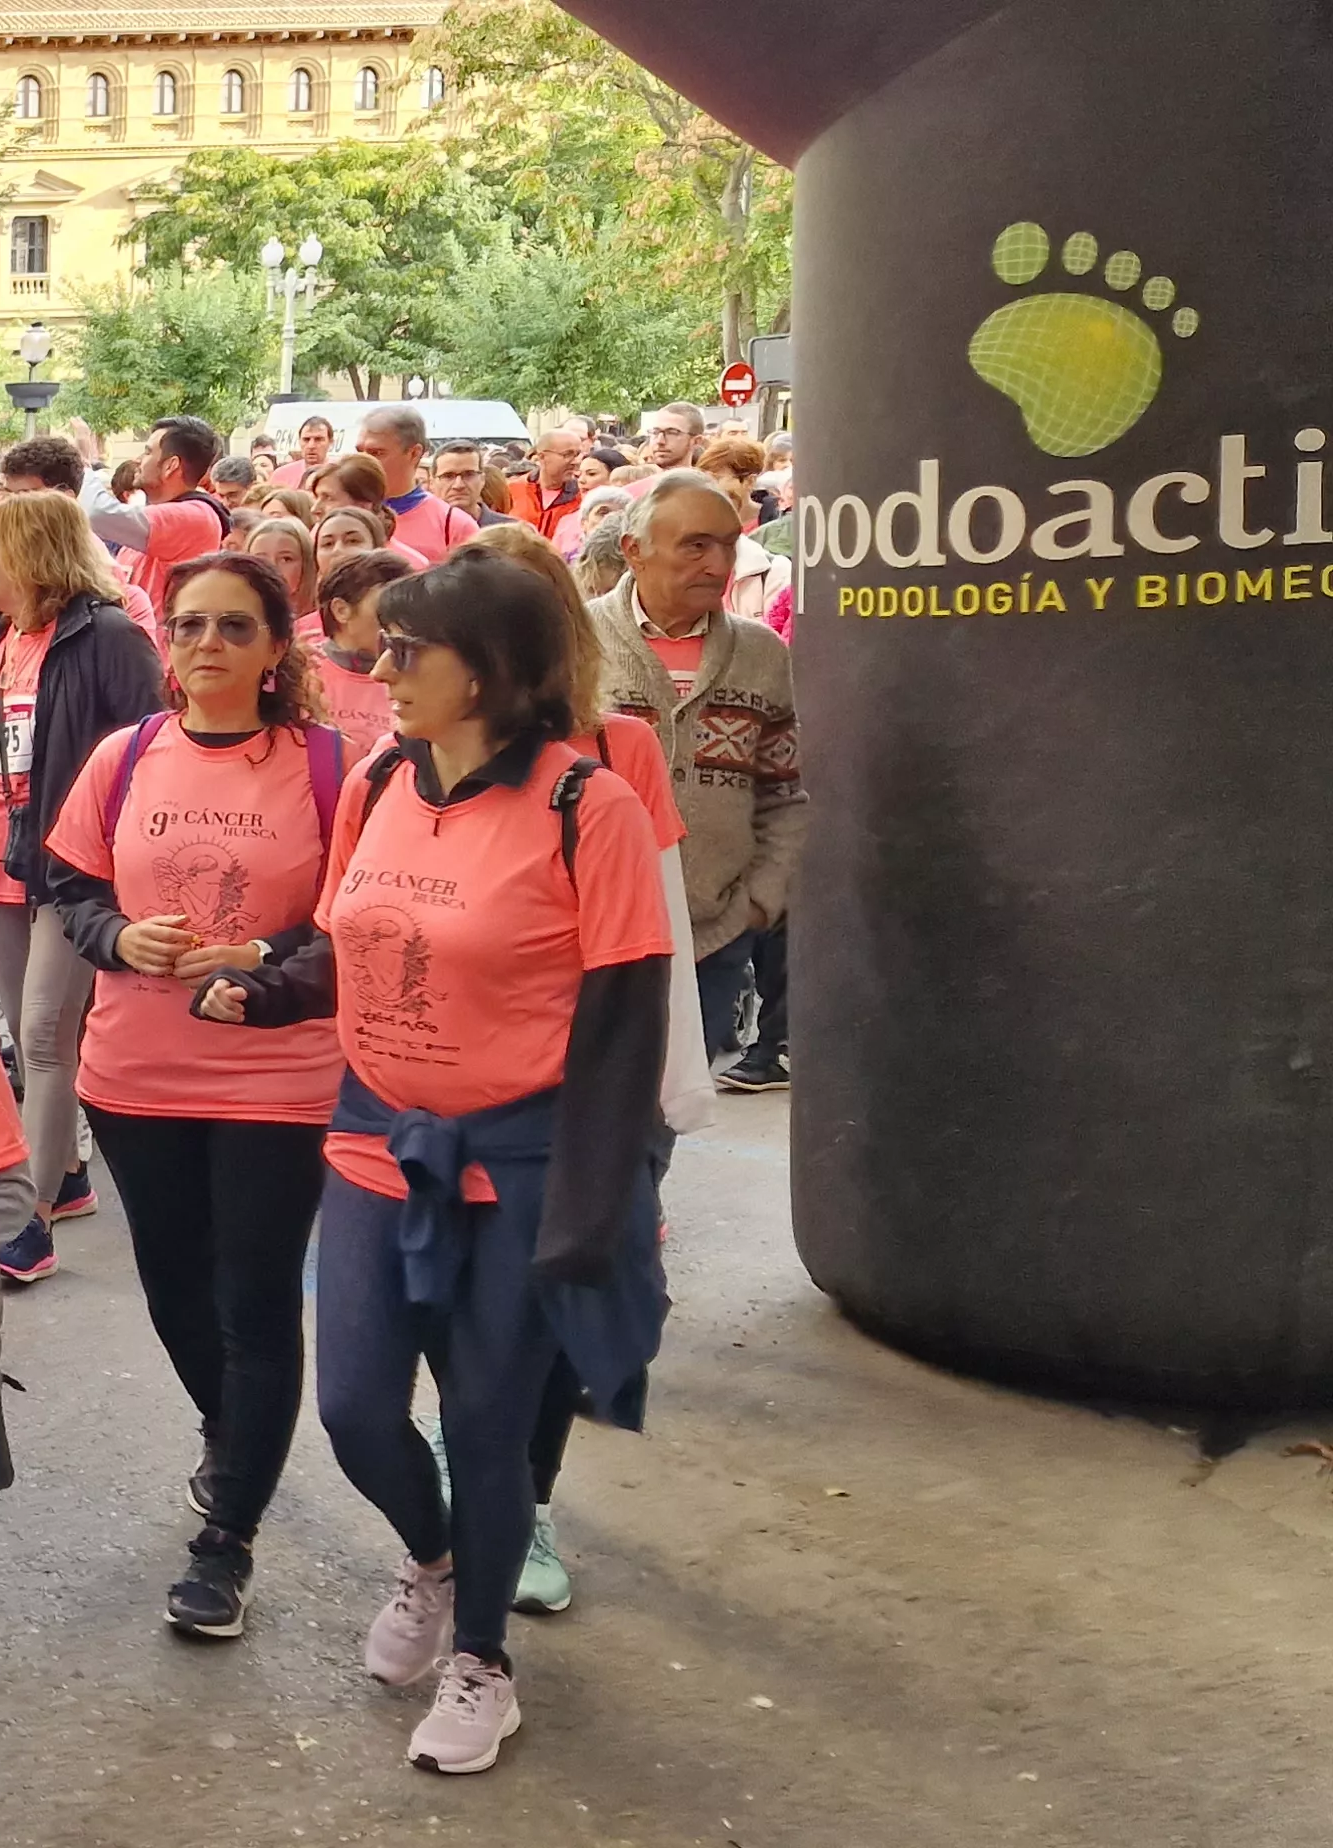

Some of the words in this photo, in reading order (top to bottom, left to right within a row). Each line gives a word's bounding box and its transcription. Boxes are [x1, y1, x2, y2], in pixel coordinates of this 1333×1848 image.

[798, 428, 1333, 614] podoacti
[838, 573, 1066, 617] PODOLOGÍA
[1086, 577, 1116, 611] Y
[183, 803, 264, 828] CÁNCER
[222, 826, 278, 840] HUESCA
[378, 870, 458, 897] CÁNCER
